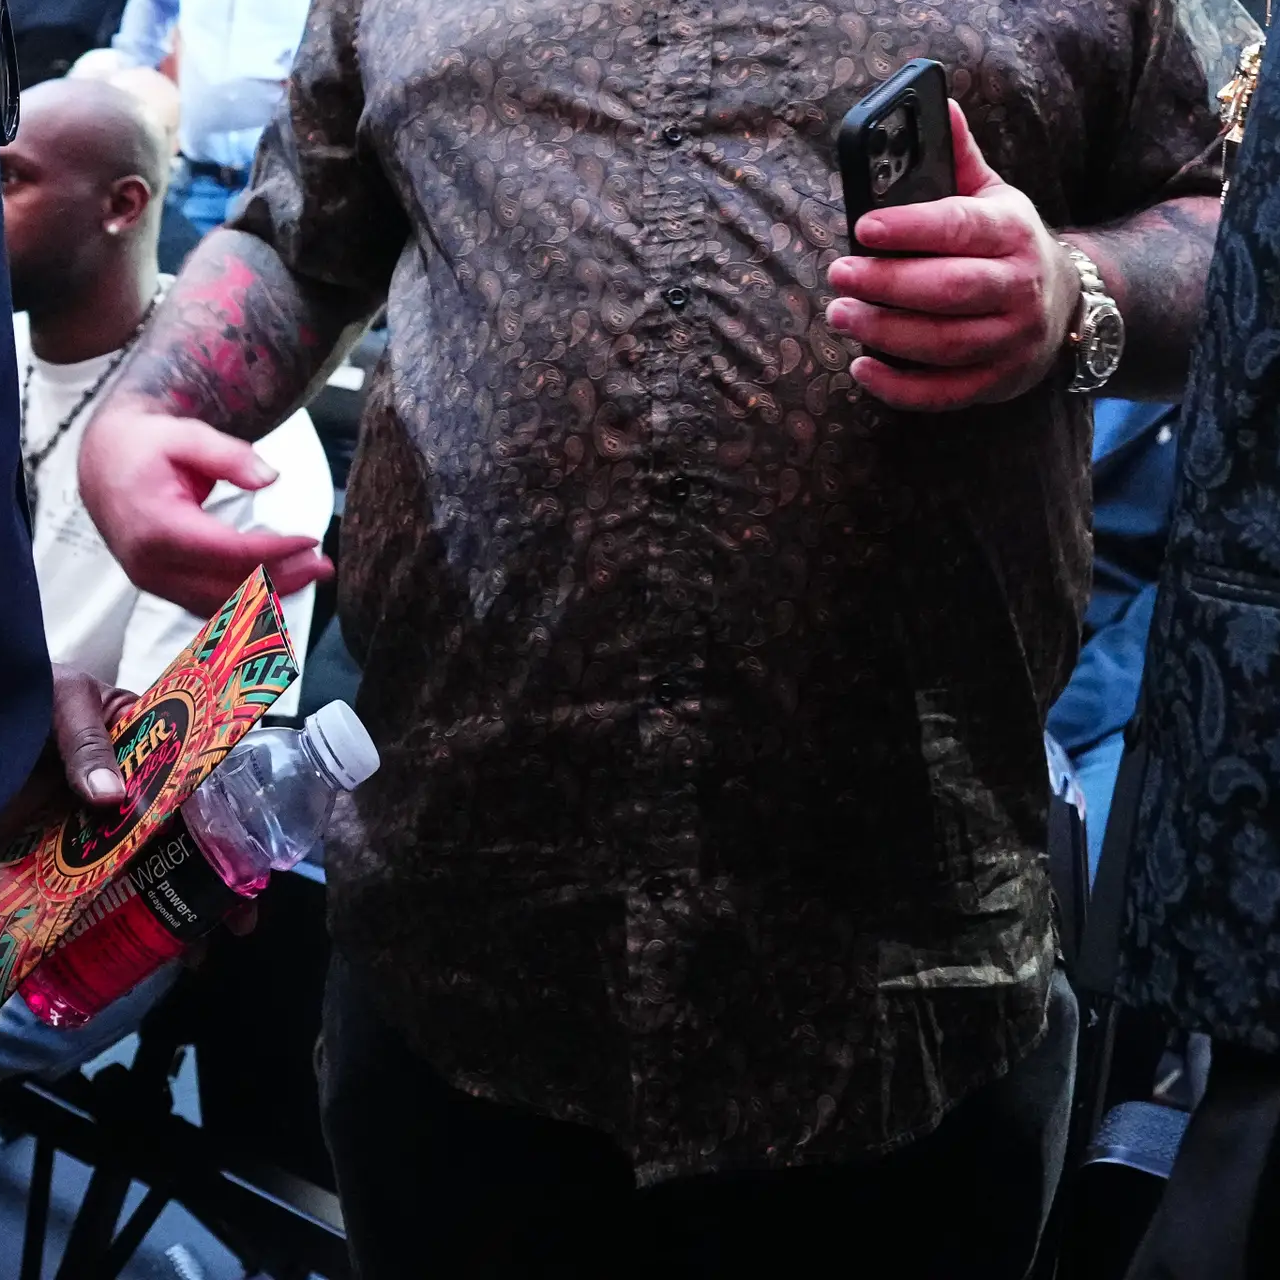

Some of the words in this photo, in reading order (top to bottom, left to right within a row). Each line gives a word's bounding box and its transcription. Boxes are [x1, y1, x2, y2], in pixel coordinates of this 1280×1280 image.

[48, 833, 190, 957] aminwater
[147, 890, 181, 929] dragonfruit
[157, 879, 198, 923] power-c
